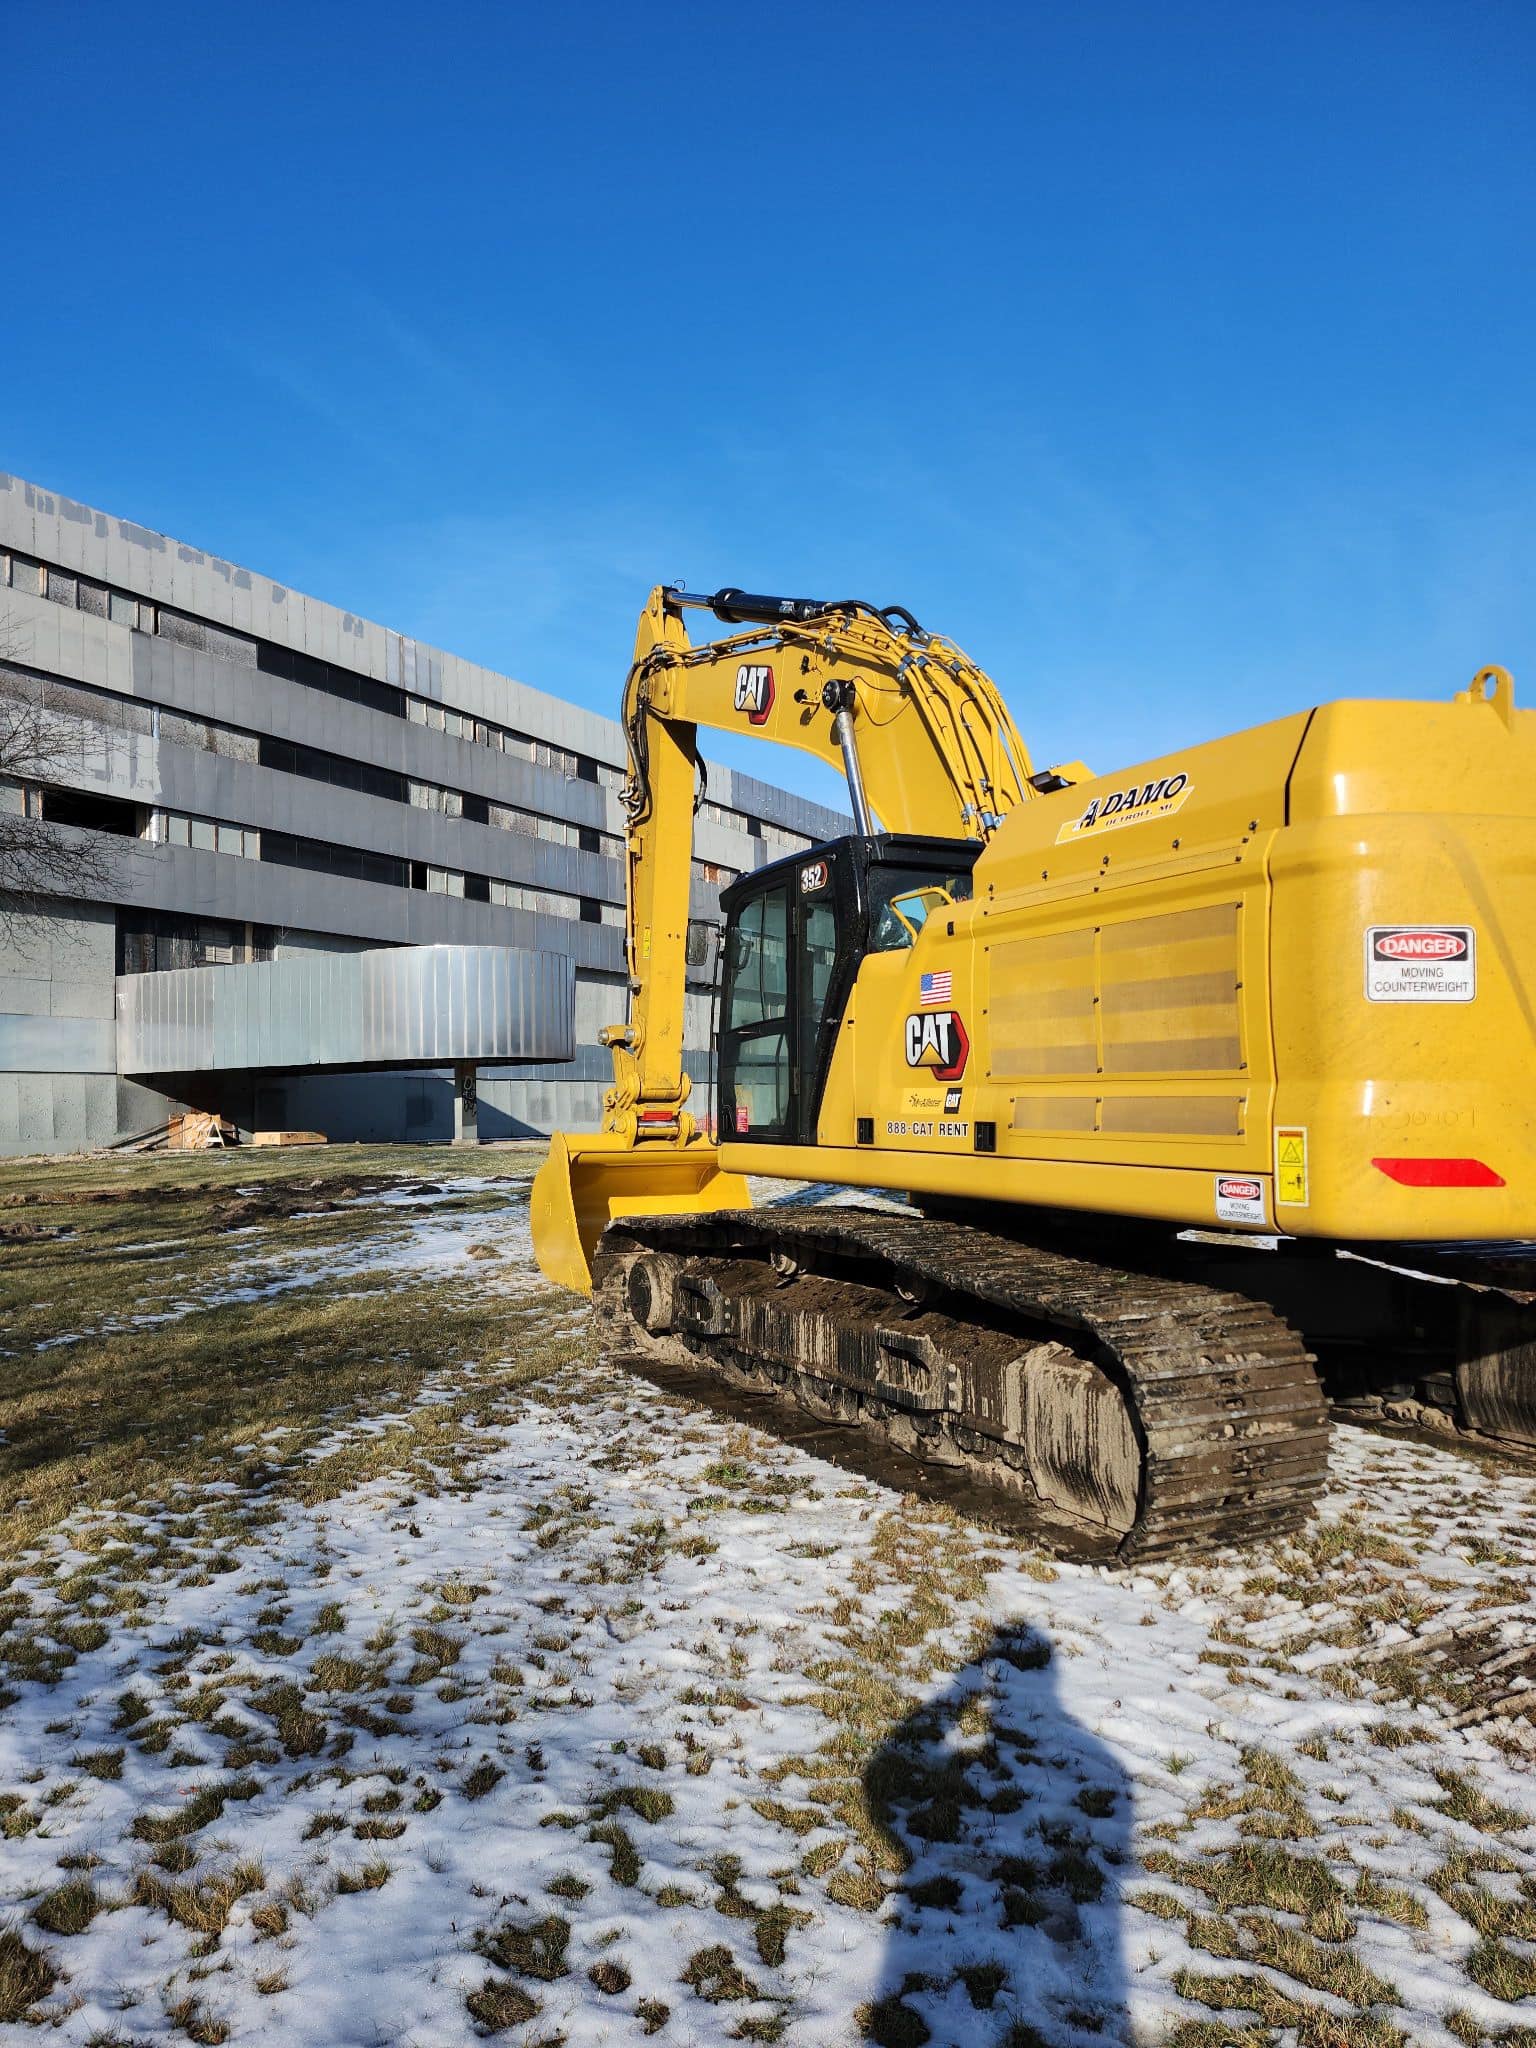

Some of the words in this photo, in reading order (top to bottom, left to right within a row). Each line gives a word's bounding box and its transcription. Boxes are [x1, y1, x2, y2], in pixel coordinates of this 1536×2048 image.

[736, 667, 768, 710] CAT
[1073, 773, 1187, 830] ADAMO
[801, 865, 821, 890] 352
[1384, 939, 1457, 953] DANGER
[1401, 968, 1444, 977] MOVING
[1374, 982, 1469, 992] COUNTERWEIGHT
[906, 1013, 952, 1065] CAT
[945, 1094, 961, 1108] CAT
[939, 1123, 969, 1137] RENT
[1222, 1184, 1256, 1196] DANGER
